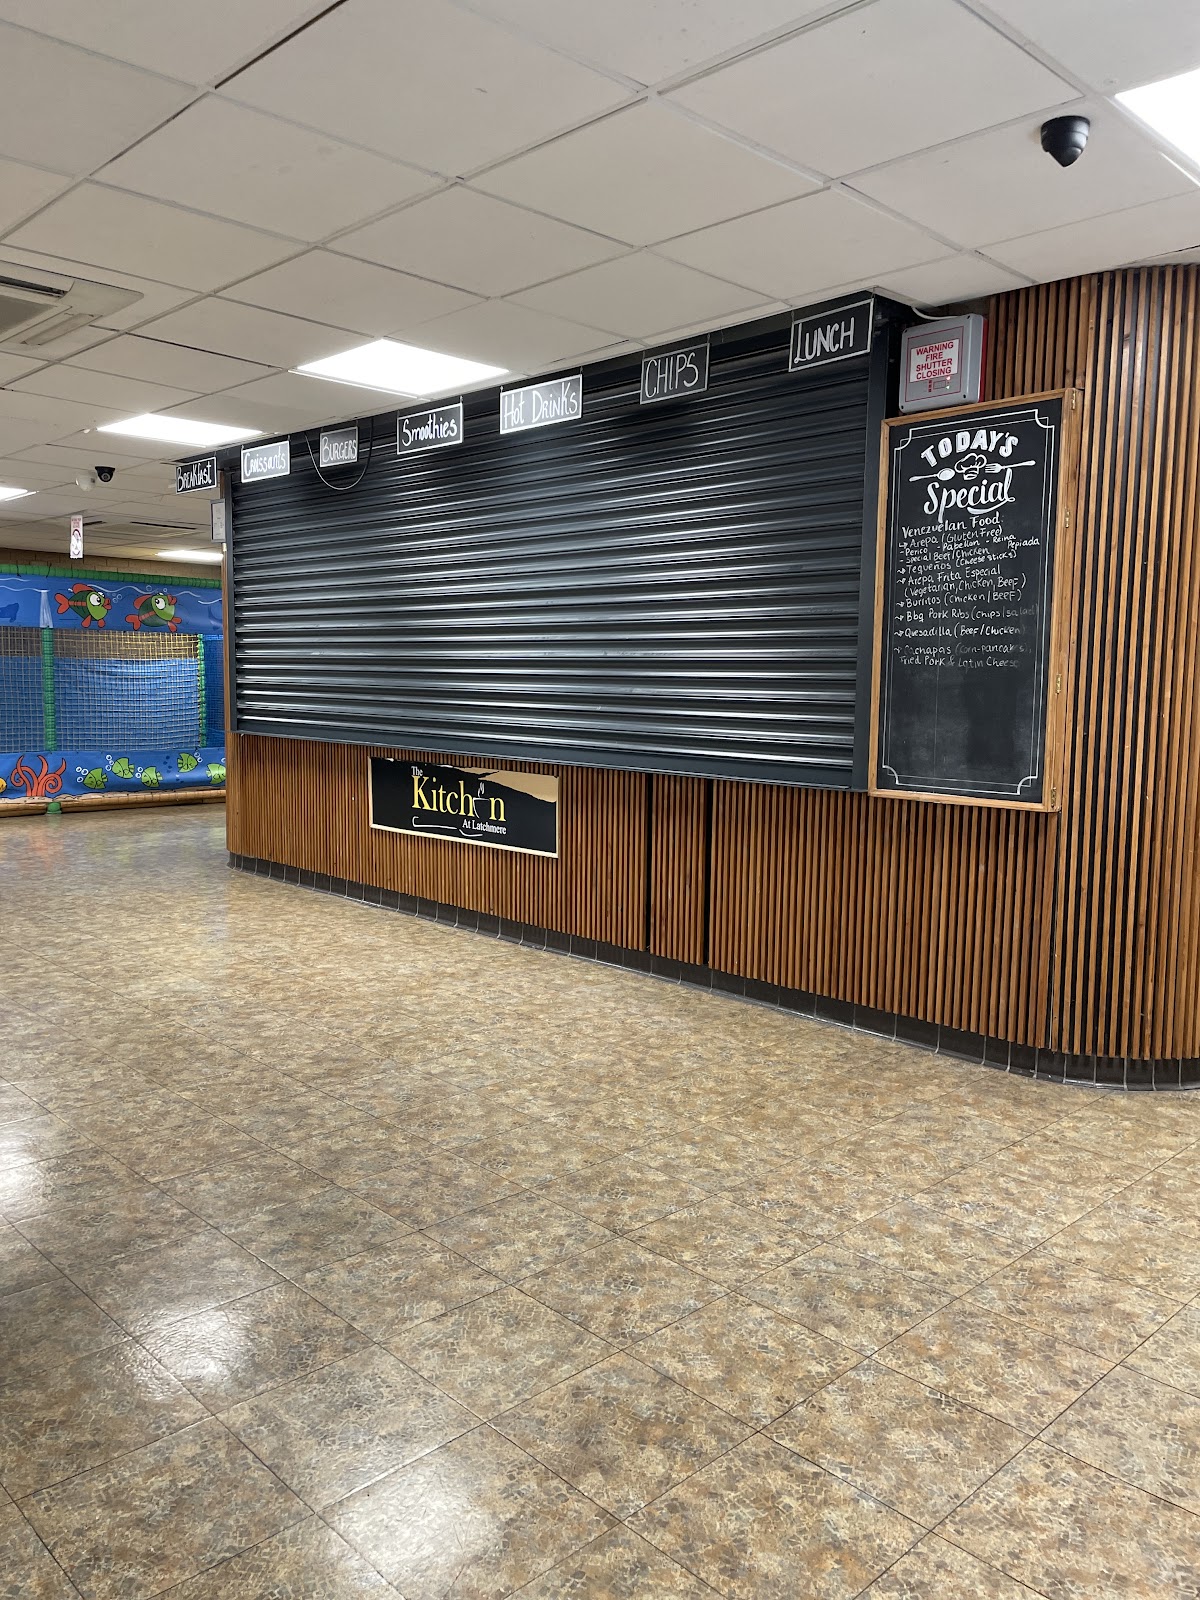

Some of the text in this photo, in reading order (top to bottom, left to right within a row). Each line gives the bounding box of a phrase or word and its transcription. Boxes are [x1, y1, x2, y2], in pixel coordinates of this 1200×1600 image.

[794, 317, 855, 364] LUNCH
[916, 341, 954, 356] WARNING
[916, 358, 953, 372] SHUTTER
[925, 351, 943, 362] FIRE
[644, 352, 699, 398] CHIPS
[916, 366, 952, 380] CLOSING
[504, 391, 525, 429] Hot
[402, 413, 458, 447] Smoothies
[322, 436, 357, 463] BURGERS
[921, 429, 1019, 468] TODAY'S
[923, 467, 1016, 523] Special
[902, 519, 967, 539] Venezuelan
[910, 524, 1003, 548] Arepa (Gluten Free)
[905, 547, 928, 557] Perico
[992, 534, 1017, 544] Reina
[1007, 536, 1040, 550] Pepiada
[908, 563, 1001, 586] Arepa Frita Especial
[906, 596, 941, 608] Burritos
[928, 607, 949, 619] Pork
[951, 608, 970, 619] Ribs
[904, 626, 953, 638] Quesadilla
[924, 655, 945, 666] Pork
[411, 766, 423, 776] The
[462, 818, 506, 835] At Latchmere
